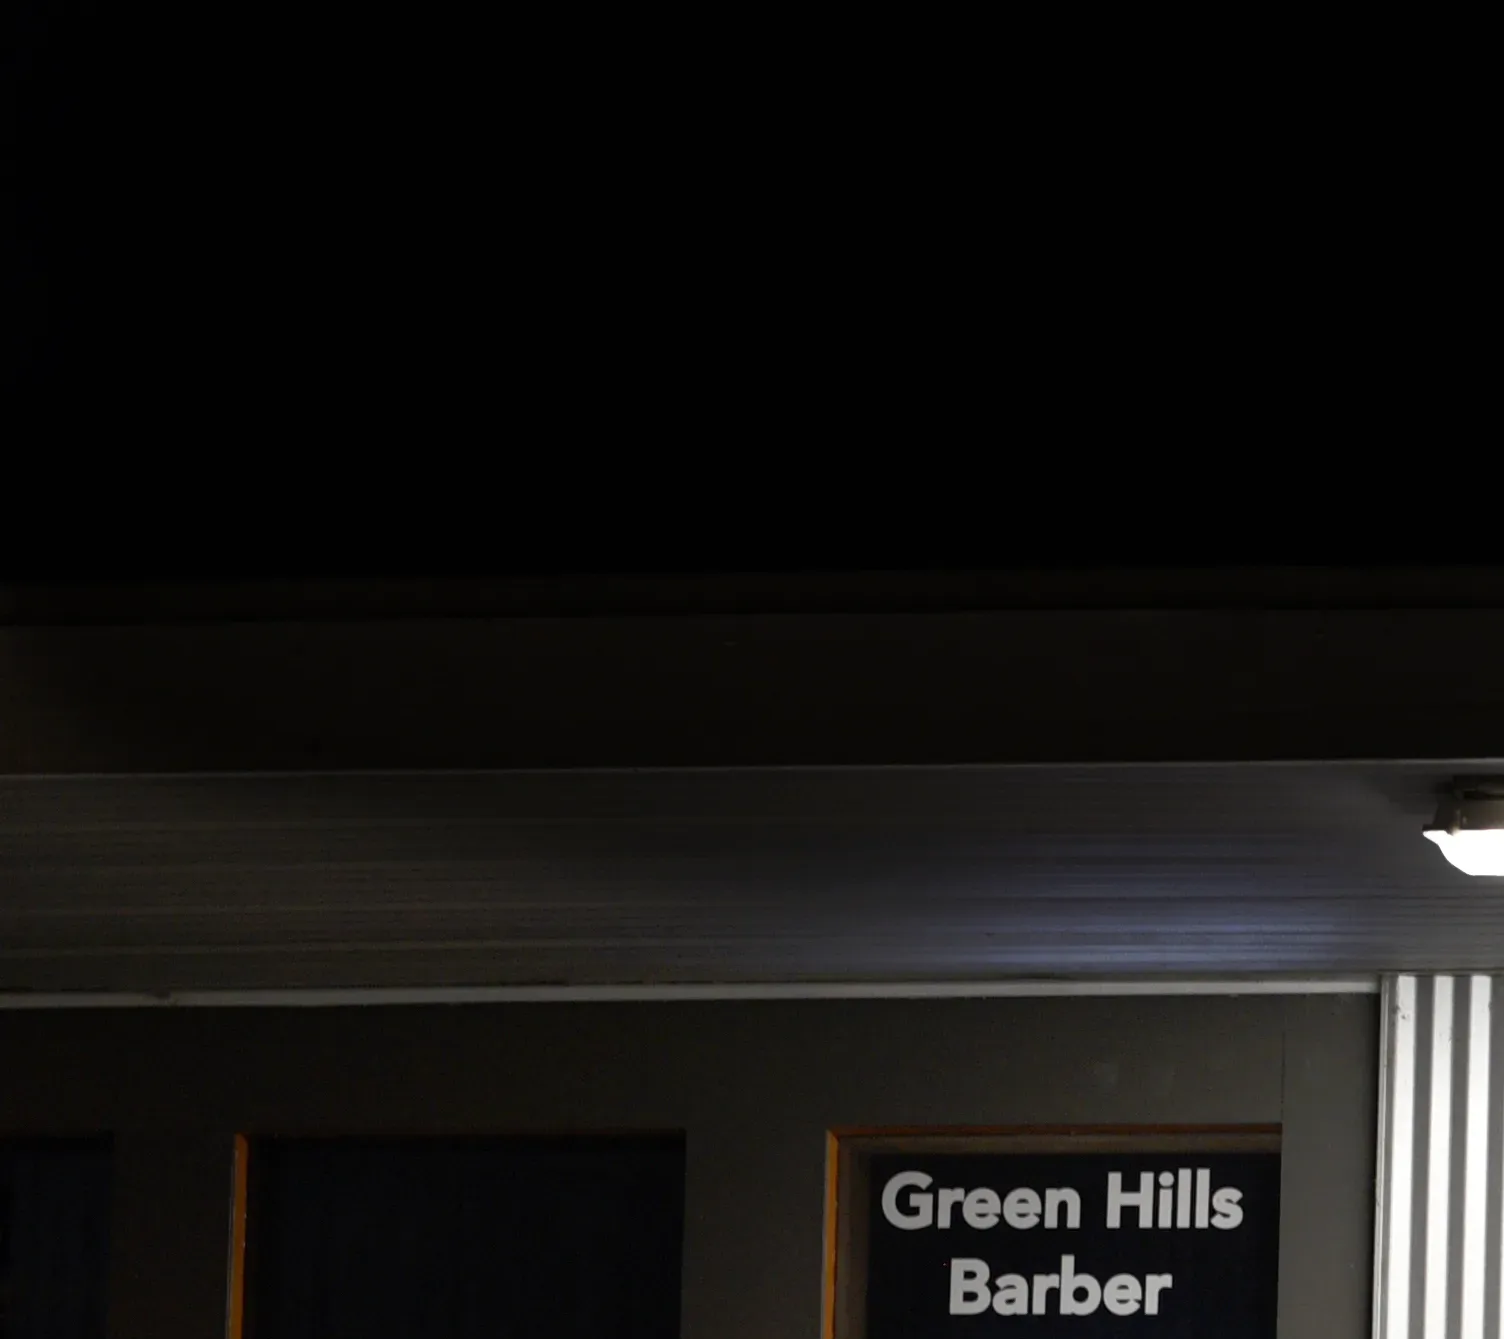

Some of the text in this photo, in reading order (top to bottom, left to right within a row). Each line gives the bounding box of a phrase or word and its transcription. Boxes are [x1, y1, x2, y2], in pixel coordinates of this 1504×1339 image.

[881, 1168, 1244, 1230] Green Hills
[949, 1254, 1173, 1316] Barber
